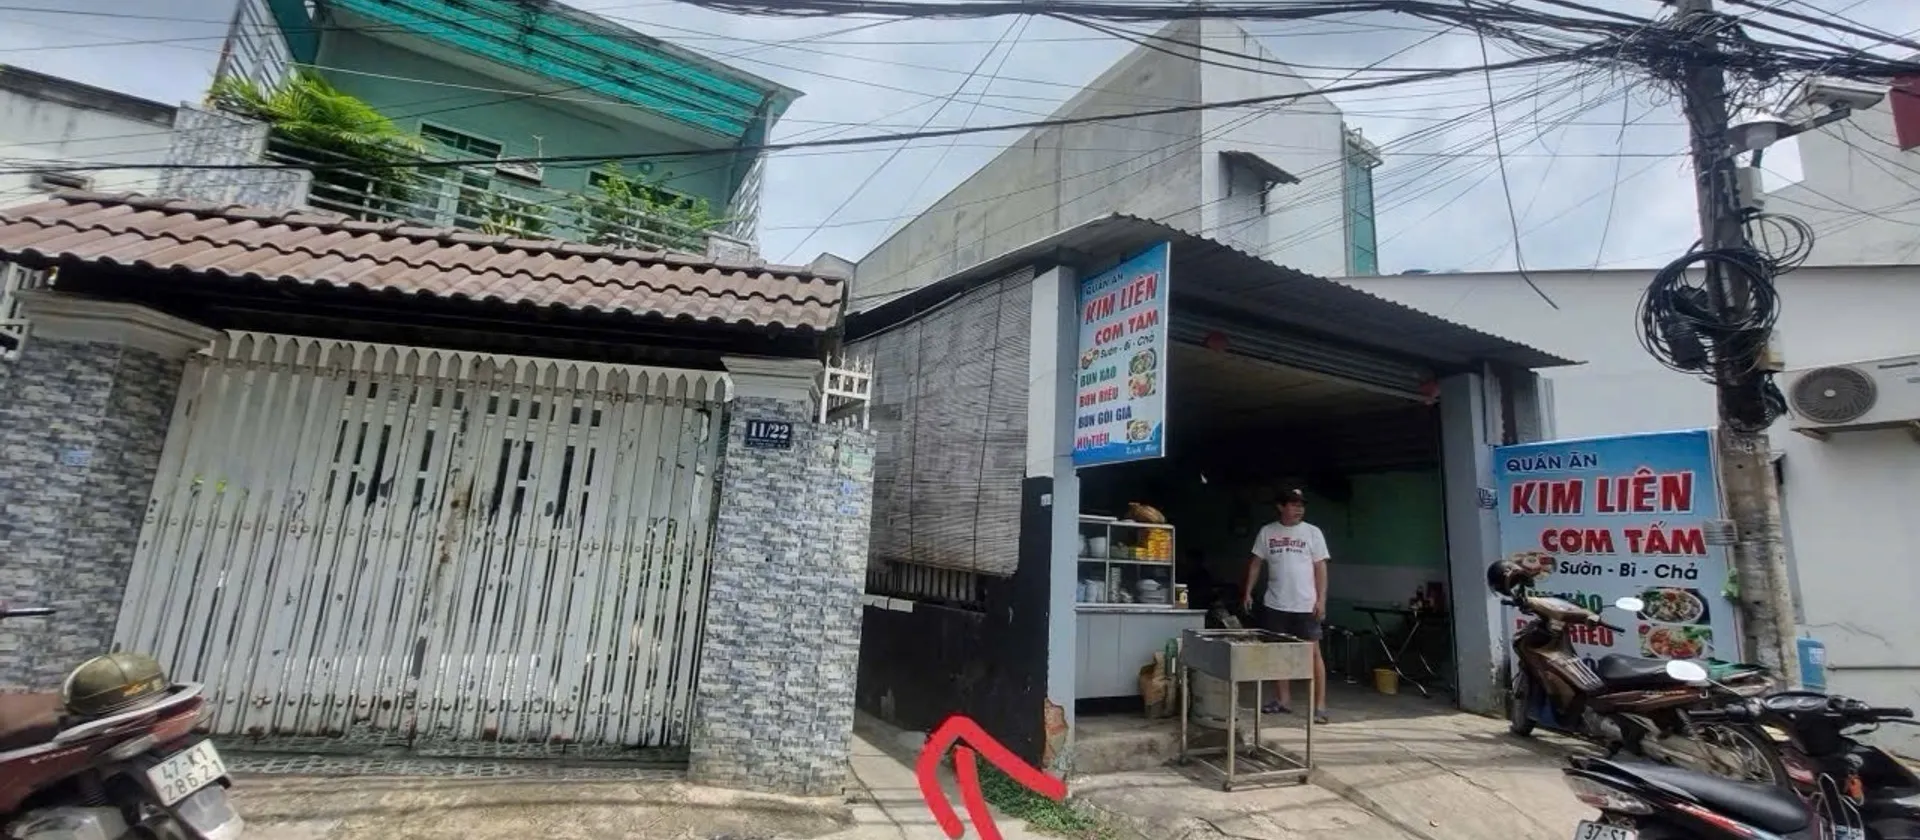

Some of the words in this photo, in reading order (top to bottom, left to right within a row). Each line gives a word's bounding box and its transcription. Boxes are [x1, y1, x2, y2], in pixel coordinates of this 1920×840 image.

[1085, 292, 1116, 325] KIM
[1120, 273, 1158, 311] LIÊN
[751, 422, 789, 439] 11/22
[1506, 452, 1561, 472] QUÁN
[1511, 479, 1584, 515] KIM
[1597, 467, 1694, 513] LIÊN
[1540, 527, 1615, 553] CƠM
[1624, 520, 1707, 555] TẤM
[1559, 560, 1602, 576] Sườn
[1619, 562, 1637, 577] Bì
[1654, 562, 1699, 580] Chả
